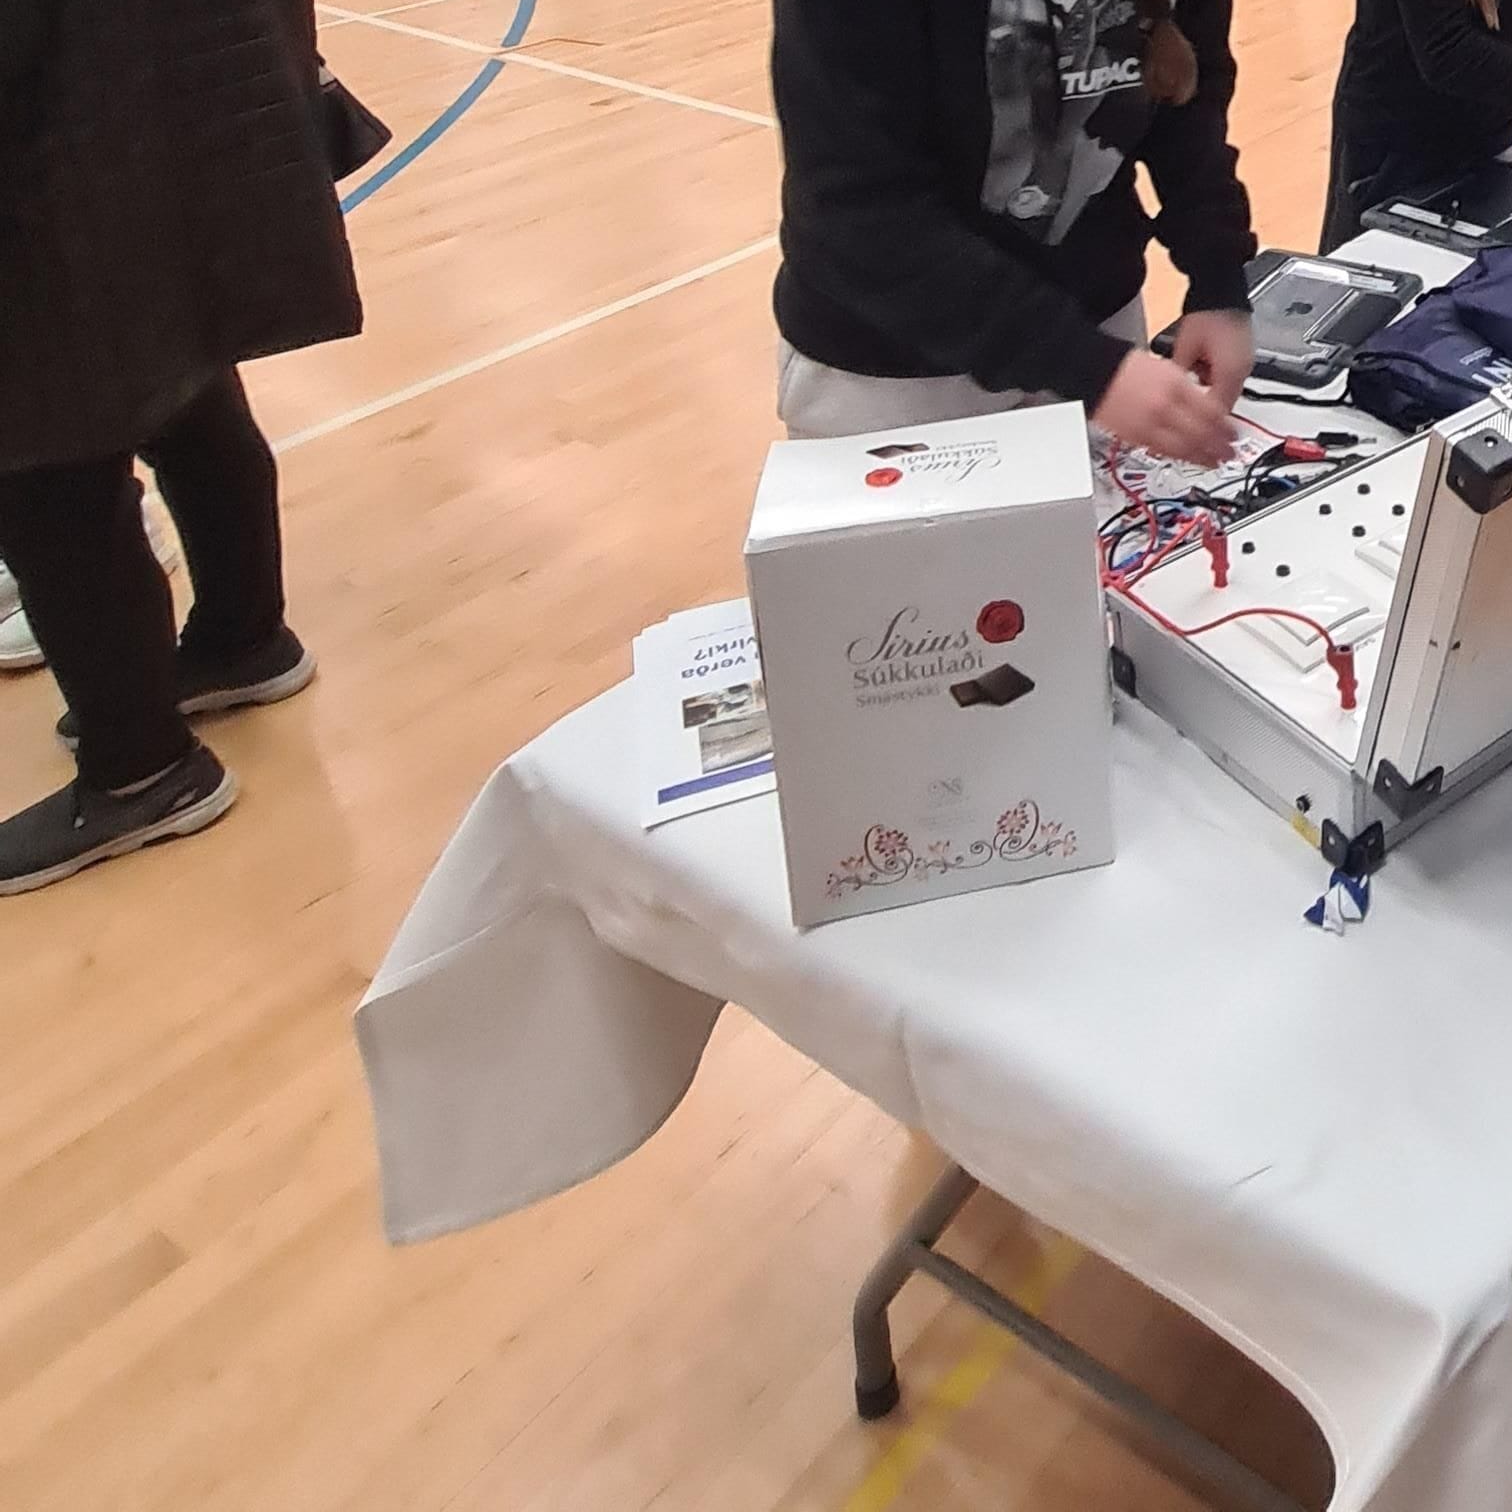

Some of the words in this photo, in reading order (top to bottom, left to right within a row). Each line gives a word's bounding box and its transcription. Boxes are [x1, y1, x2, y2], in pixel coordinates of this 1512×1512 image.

[1060, 57, 1141, 95] TUPAC
[848, 605, 969, 665] Sirius
[853, 650, 984, 688] Súkkulaði
